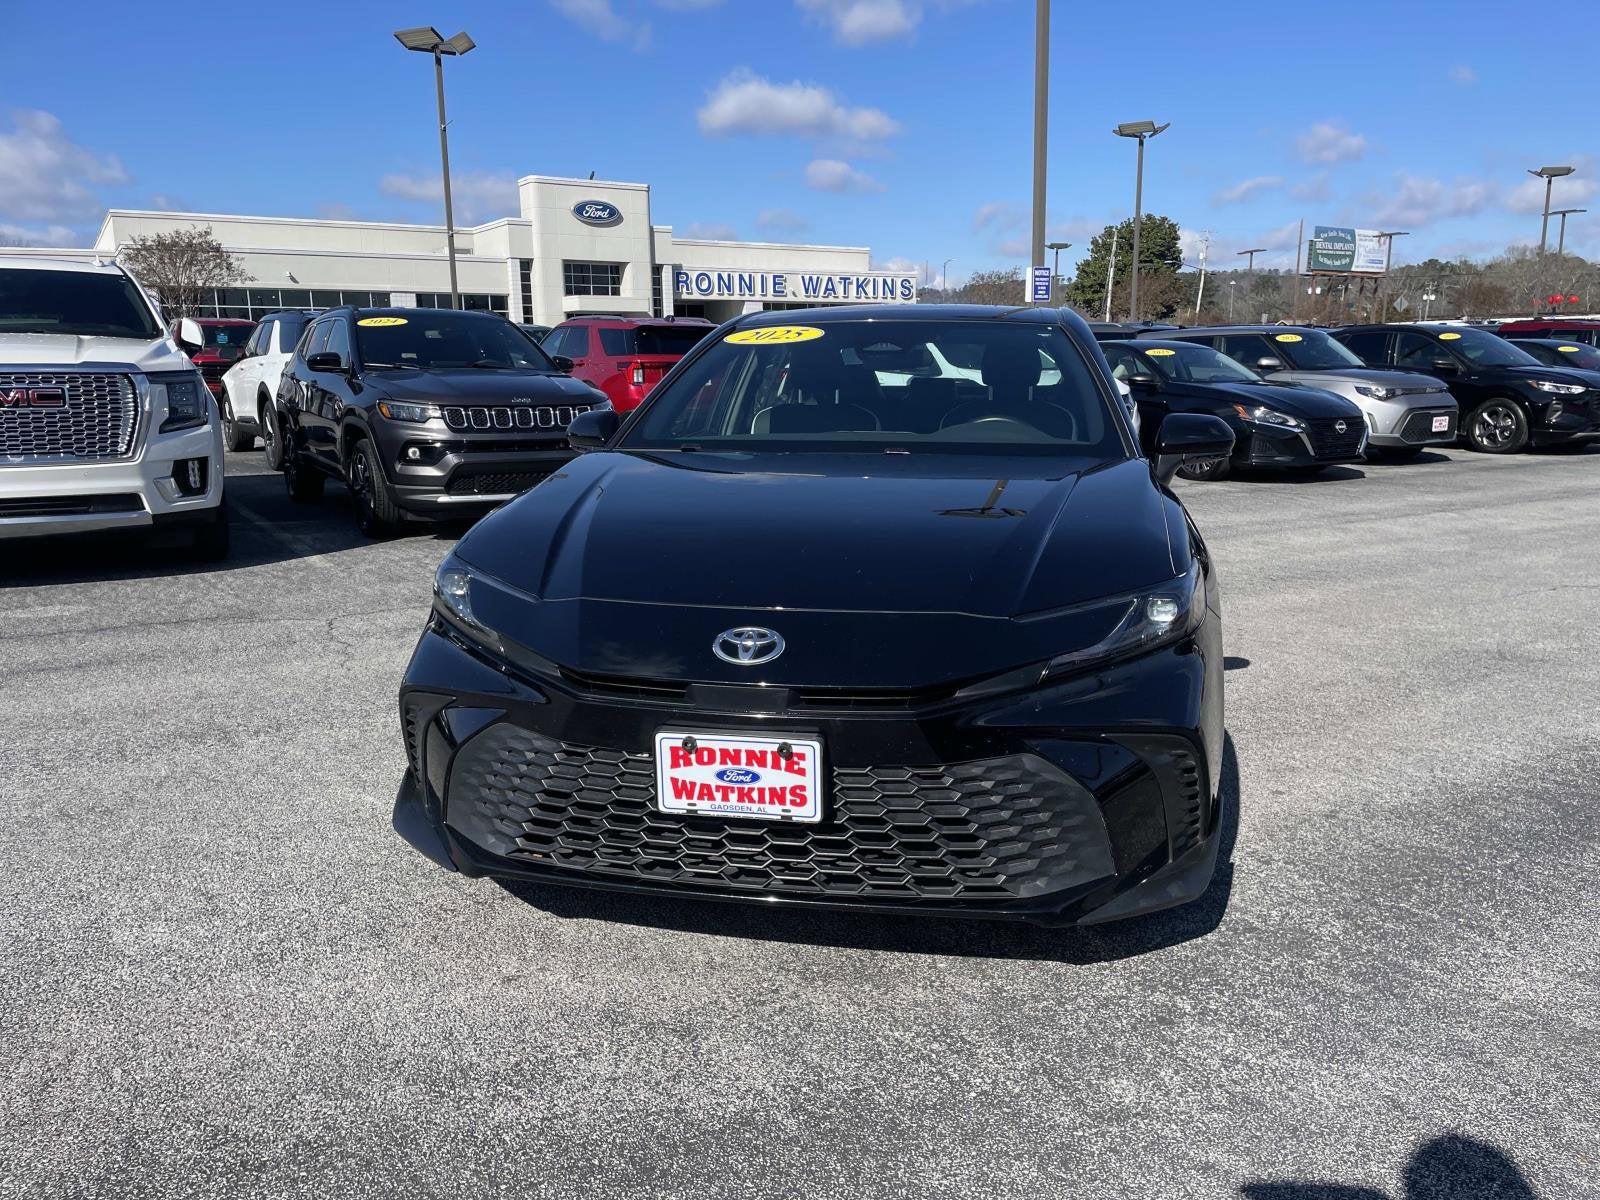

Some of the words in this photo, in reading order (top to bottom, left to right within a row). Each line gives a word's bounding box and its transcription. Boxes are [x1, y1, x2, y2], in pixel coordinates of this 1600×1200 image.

[583, 205, 610, 218] Ford
[675, 271, 787, 296] RONNIE
[801, 275, 914, 299] WATKINS
[739, 329, 810, 341] 2025
[0, 388, 63, 406] MC
[669, 746, 807, 777] RONNIE
[723, 767, 752, 782] Ford
[670, 777, 808, 807] WATKINS
[710, 803, 754, 812] GADSDEN,
[756, 804, 768, 813] AL
